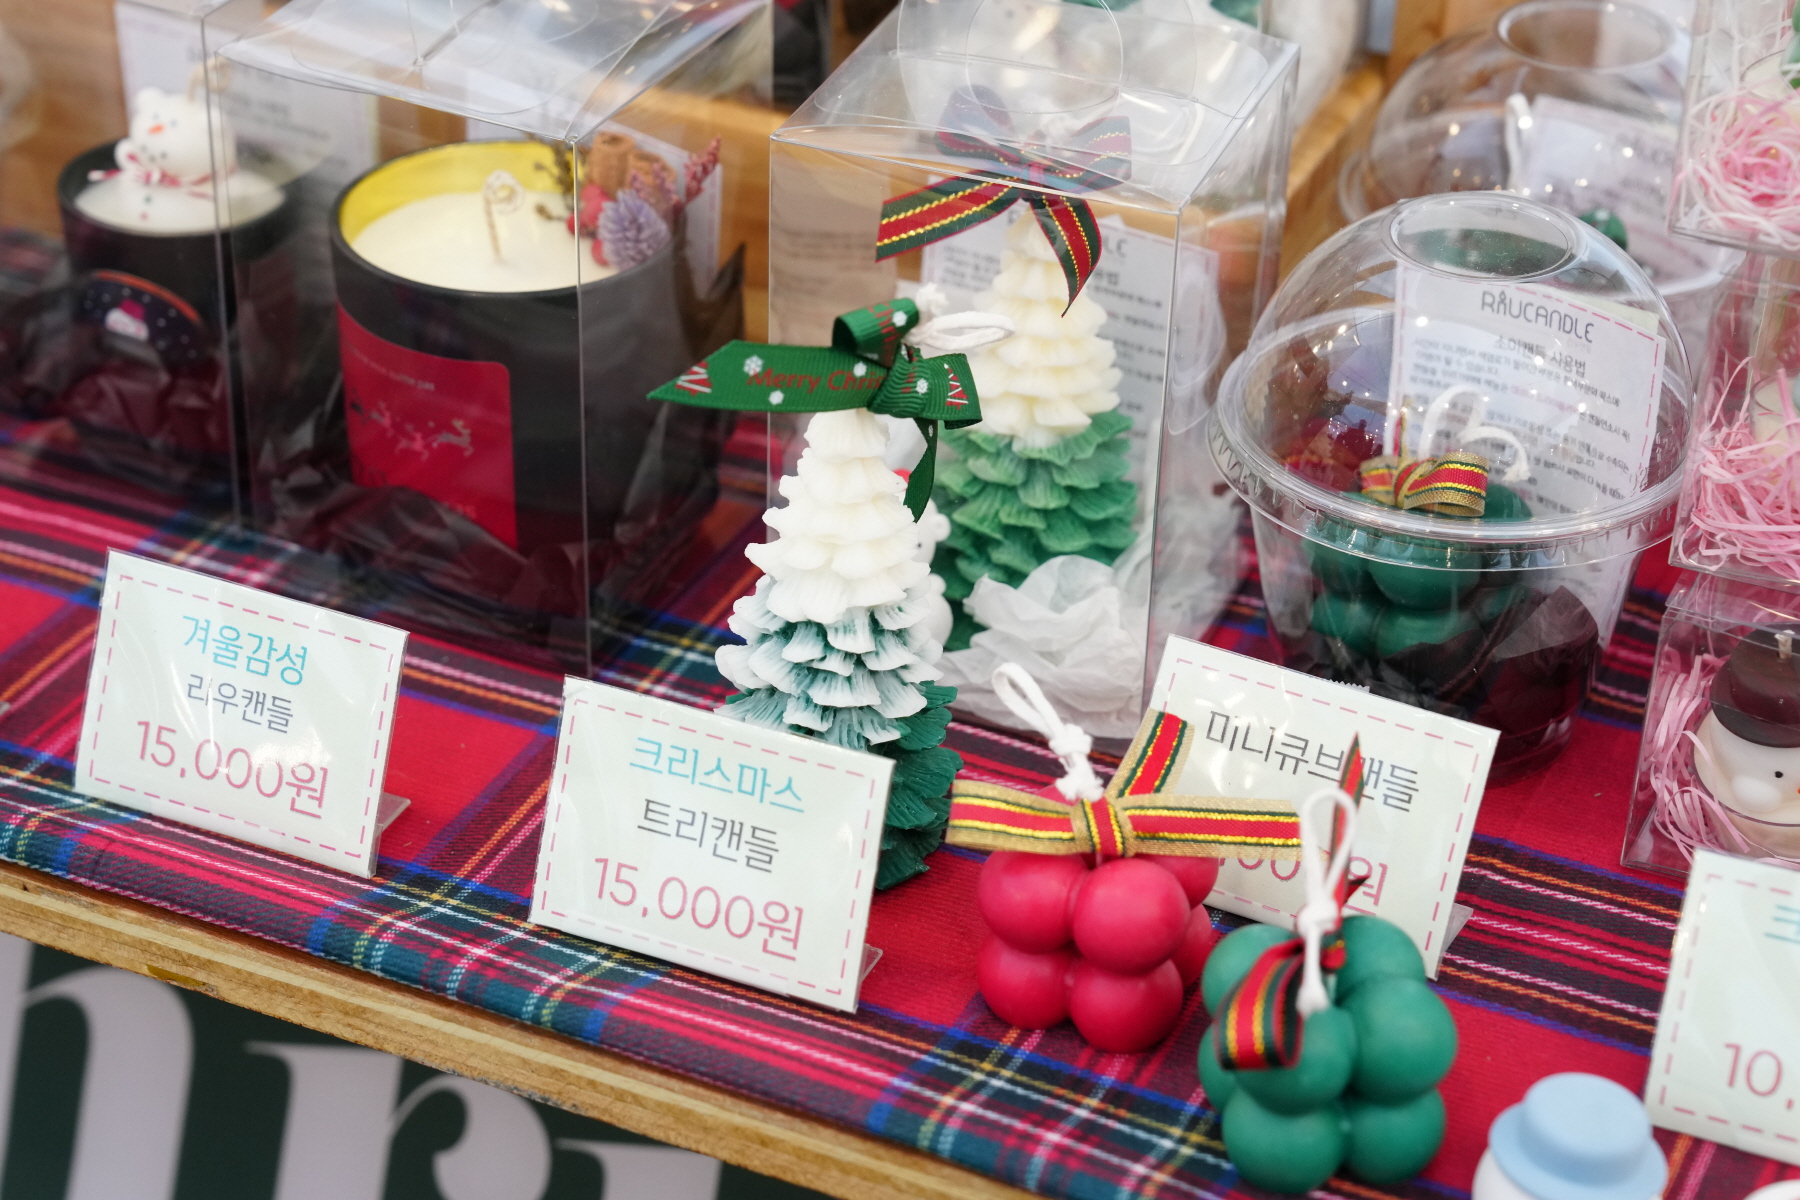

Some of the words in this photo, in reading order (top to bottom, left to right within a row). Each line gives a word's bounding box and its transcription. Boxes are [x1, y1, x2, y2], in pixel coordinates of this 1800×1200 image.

[747, 368, 821, 393] Merry
[1550, 351, 1586, 378] 사용법
[183, 615, 308, 686] 겨울감성
[187, 673, 293, 734] 리우캔들
[137, 720, 328, 819] 15,000원
[630, 737, 804, 813] 크리스마스
[637, 798, 780, 873] 트리캔들
[594, 857, 804, 961] 15,000원
